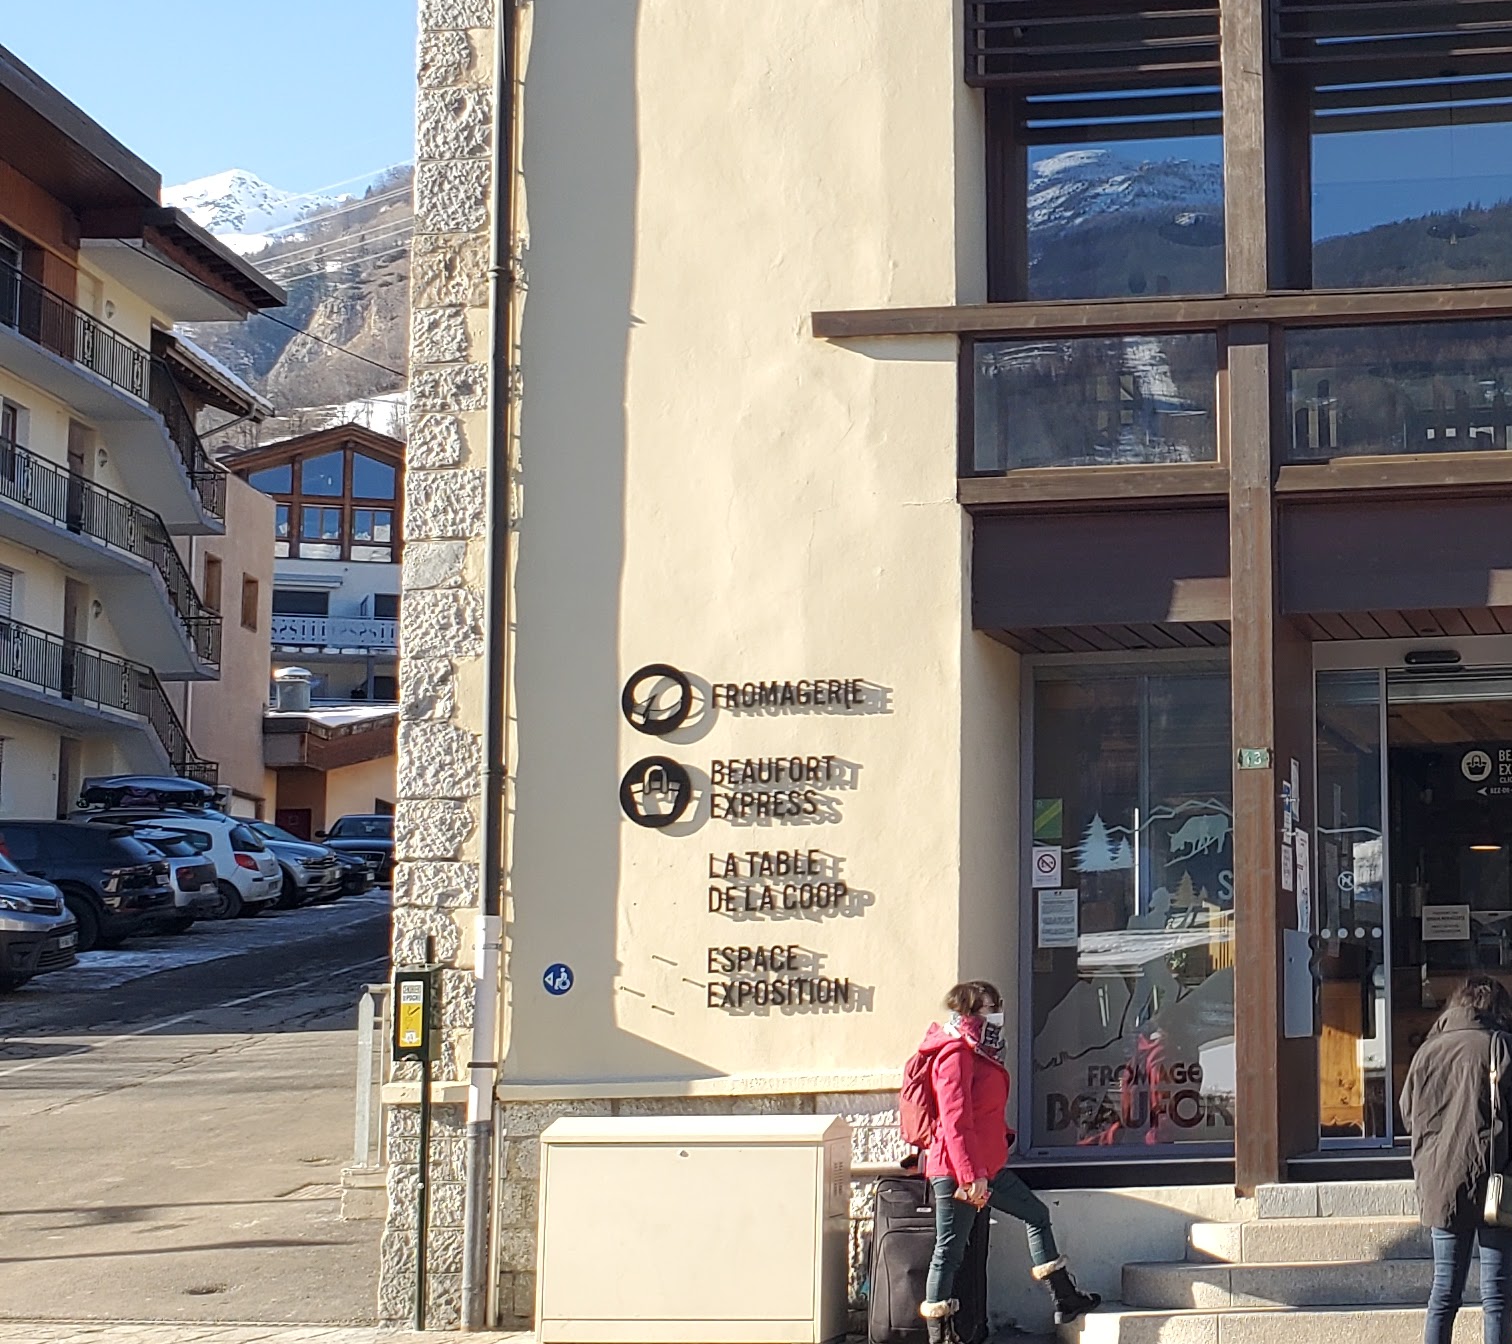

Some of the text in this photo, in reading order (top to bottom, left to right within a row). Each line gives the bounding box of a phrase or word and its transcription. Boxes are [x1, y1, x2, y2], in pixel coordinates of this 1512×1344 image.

[711, 678, 865, 709] FROMAGERIE
[711, 755, 835, 785] BEAUFORT
[710, 790, 817, 818] EXPRESS
[709, 849, 820, 878] LA TABLE
[708, 882, 848, 913] DE LA COOP
[708, 944, 799, 973] ESPACE
[707, 977, 849, 1007] EXPOSITION
